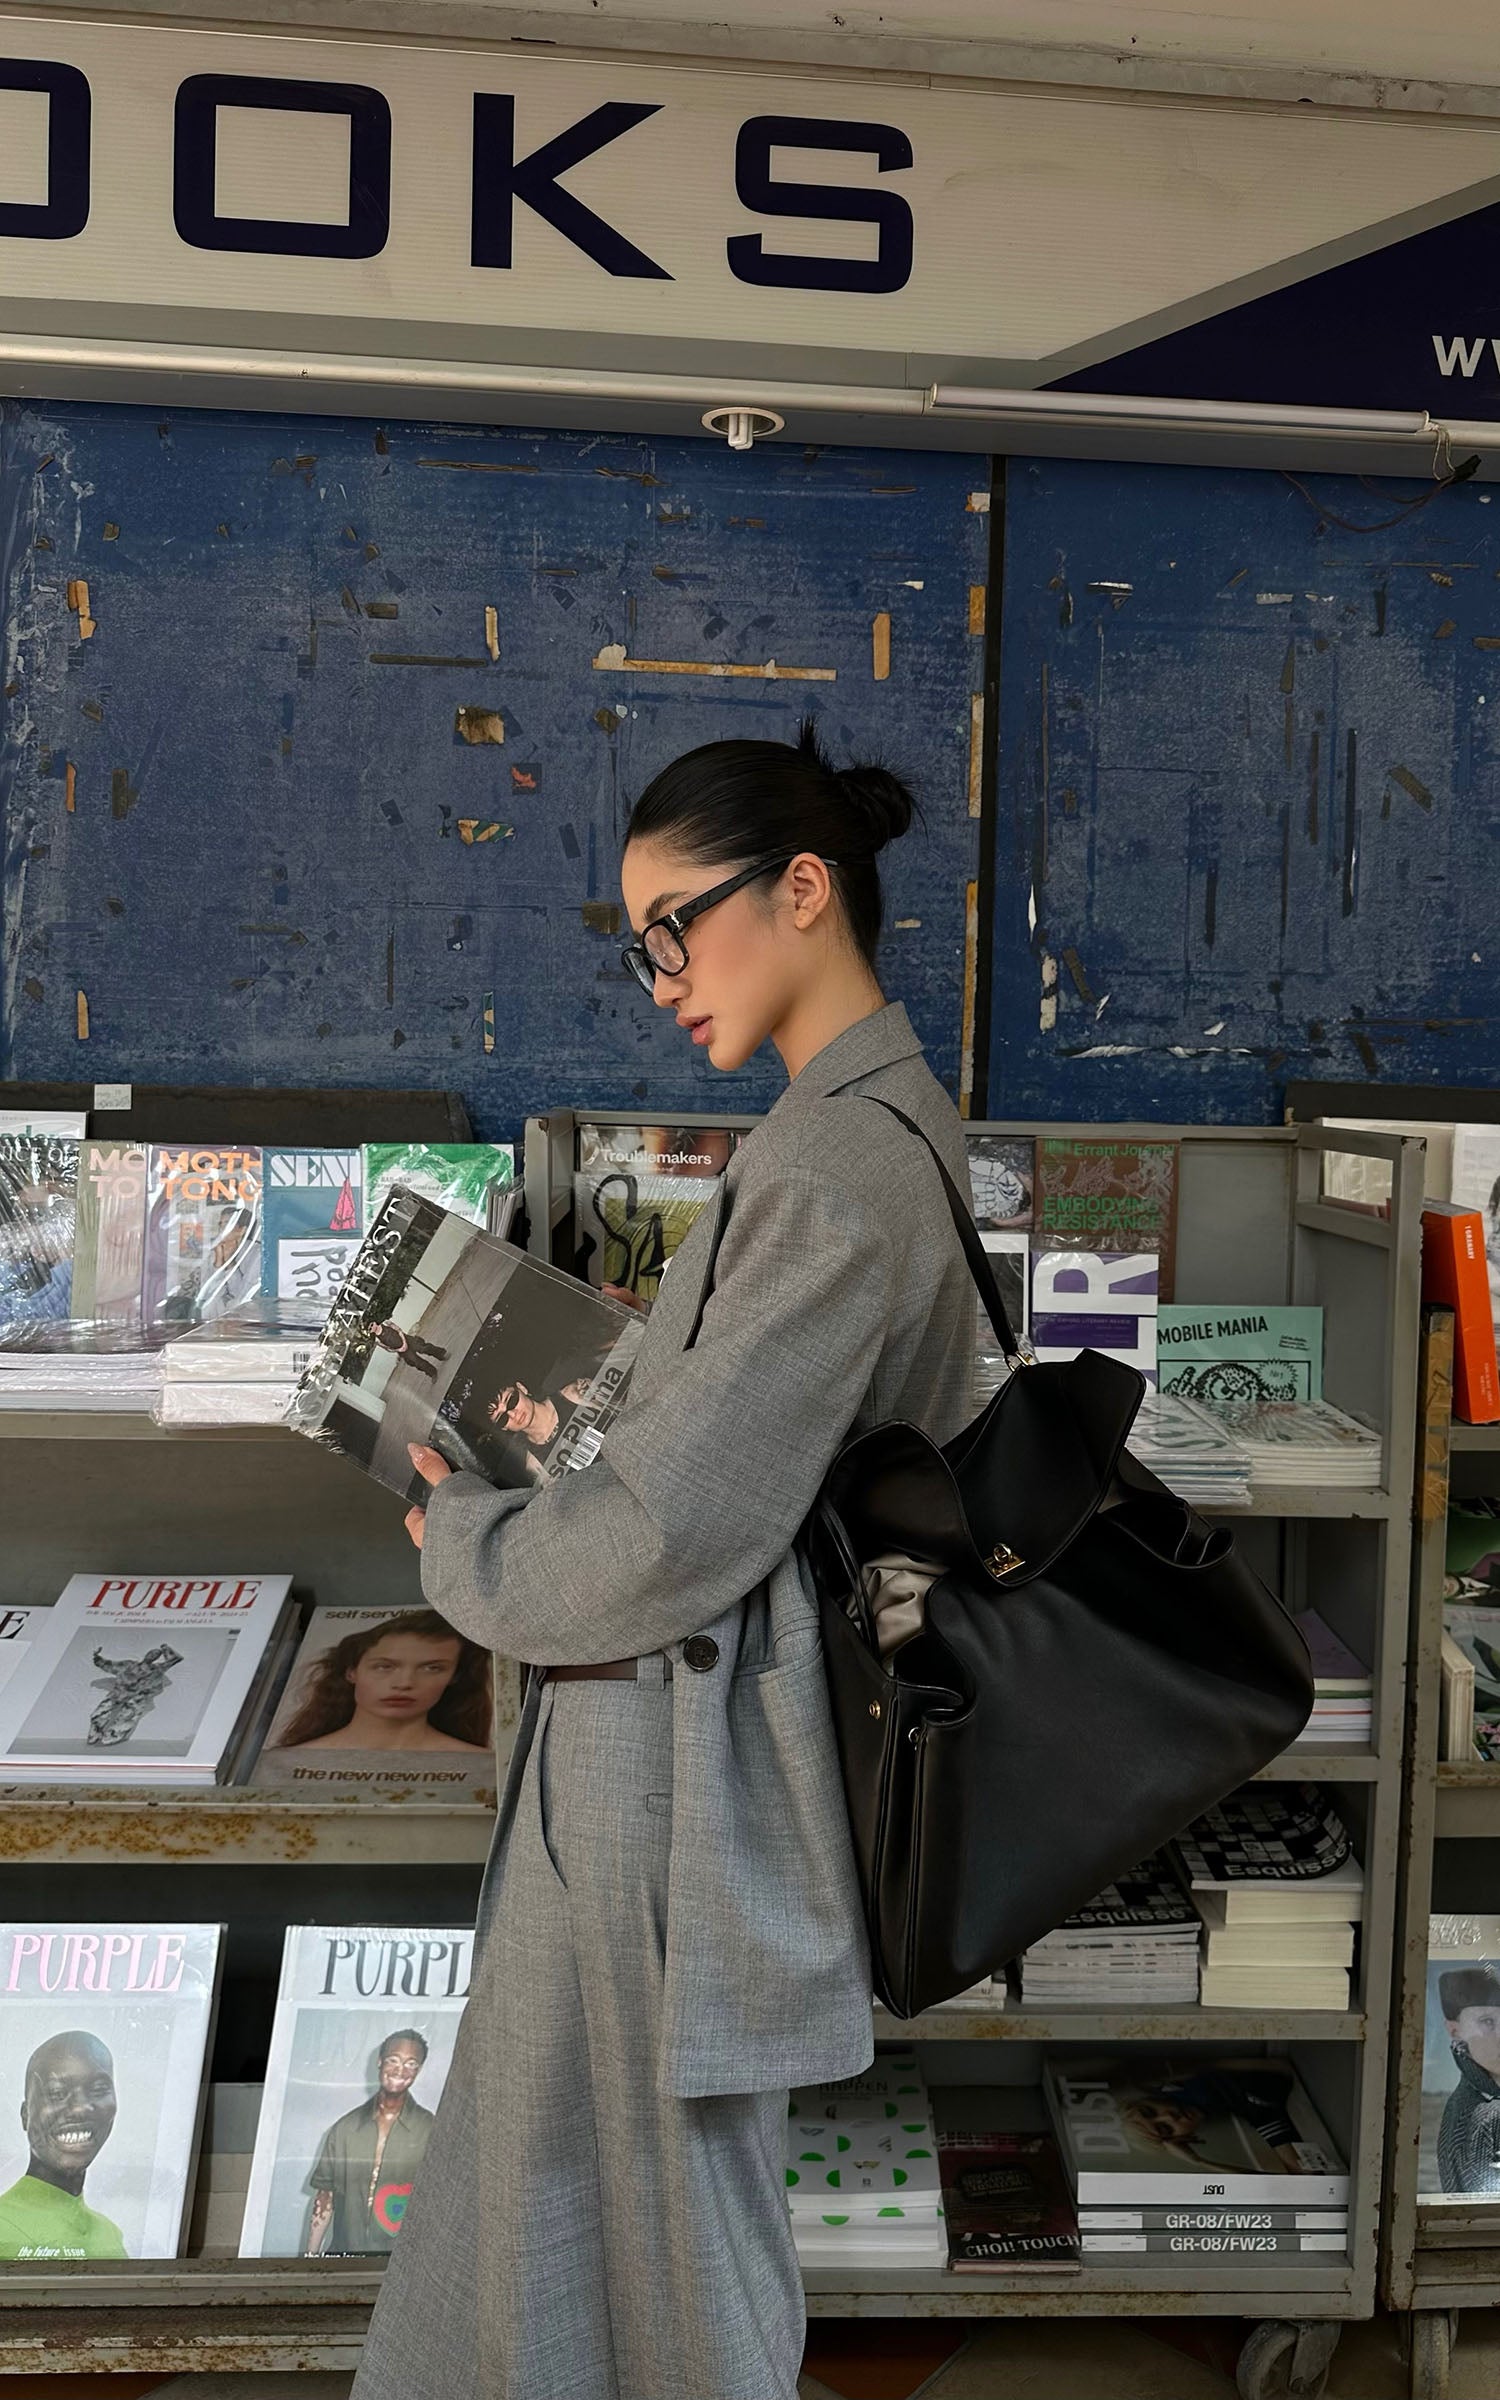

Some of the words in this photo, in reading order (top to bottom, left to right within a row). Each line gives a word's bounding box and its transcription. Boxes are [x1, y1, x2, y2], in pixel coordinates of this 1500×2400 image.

[600, 1148, 713, 1166] Troublemakers
[1074, 1142, 1118, 1157] Errant
[1043, 1195, 1160, 1214] EMBODYING
[1043, 1213, 1161, 1231] RESISTANCE
[1157, 1322, 1213, 1345] MOBILE
[1217, 1315, 1268, 1337] MANIA
[87, 1580, 262, 1610] PURPLE
[325, 1609, 359, 1620] self
[292, 1767, 327, 1781] the
[329, 1769, 375, 1782] new
[375, 1771, 421, 1782] new
[422, 1771, 468, 1782] new
[5, 1934, 187, 1993] PURPLE
[1058, 2075, 1130, 2155] DUST
[1203, 2184, 1225, 2195] DUST
[1166, 2213, 1273, 2230] GR-08/FW23
[18, 2246, 33, 2257] the
[33, 2246, 61, 2257] future
[62, 2246, 86, 2257] issue
[966, 2240, 1016, 2257] CHOI!
[1018, 2234, 1080, 2251] TOUCH
[1170, 2236, 1278, 2252] GR-08/FW23
